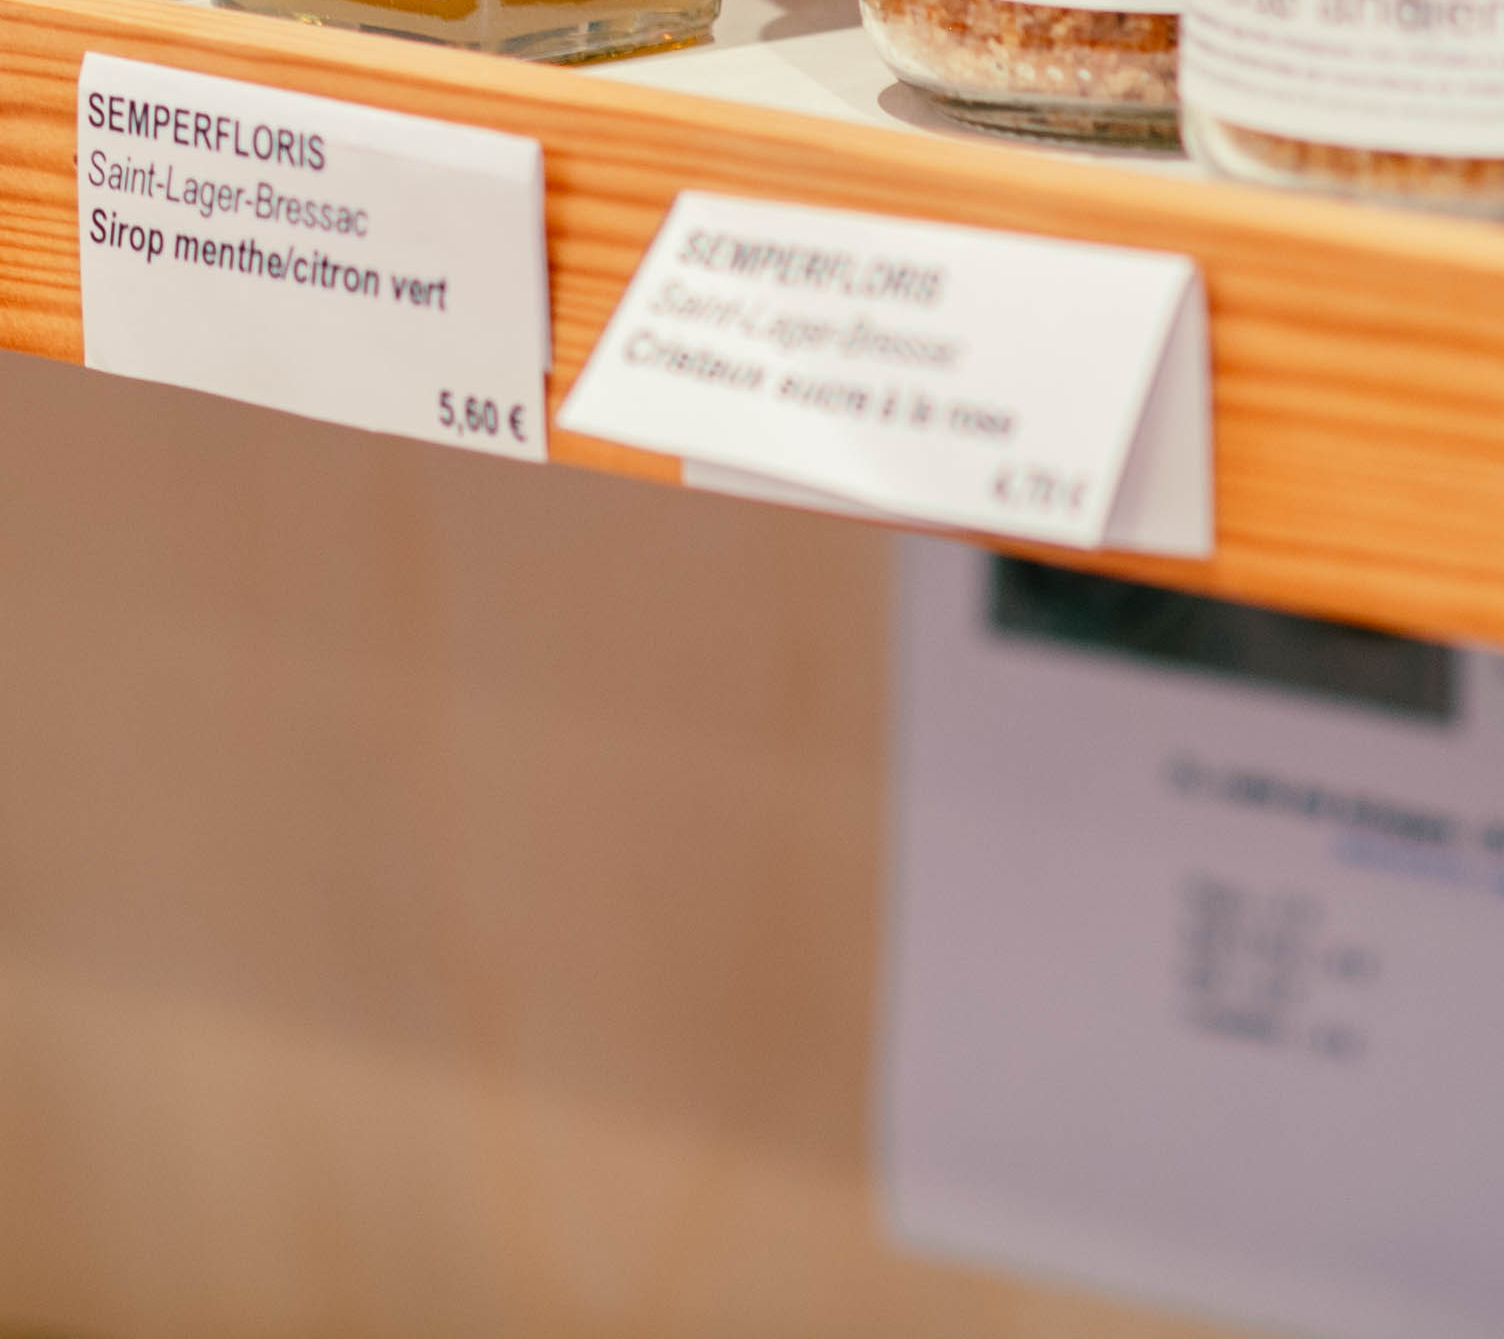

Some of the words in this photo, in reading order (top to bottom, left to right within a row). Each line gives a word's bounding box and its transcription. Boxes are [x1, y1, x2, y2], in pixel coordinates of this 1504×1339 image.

[87, 92, 327, 171] SEMPERFLORIS
[87, 150, 369, 238] Saint-Lager-Bressac
[90, 208, 164, 262] Sirop
[174, 229, 380, 298] menthe/citron
[391, 274, 449, 312] vert
[438, 390, 500, 437] 5,60
[508, 404, 528, 442] €
